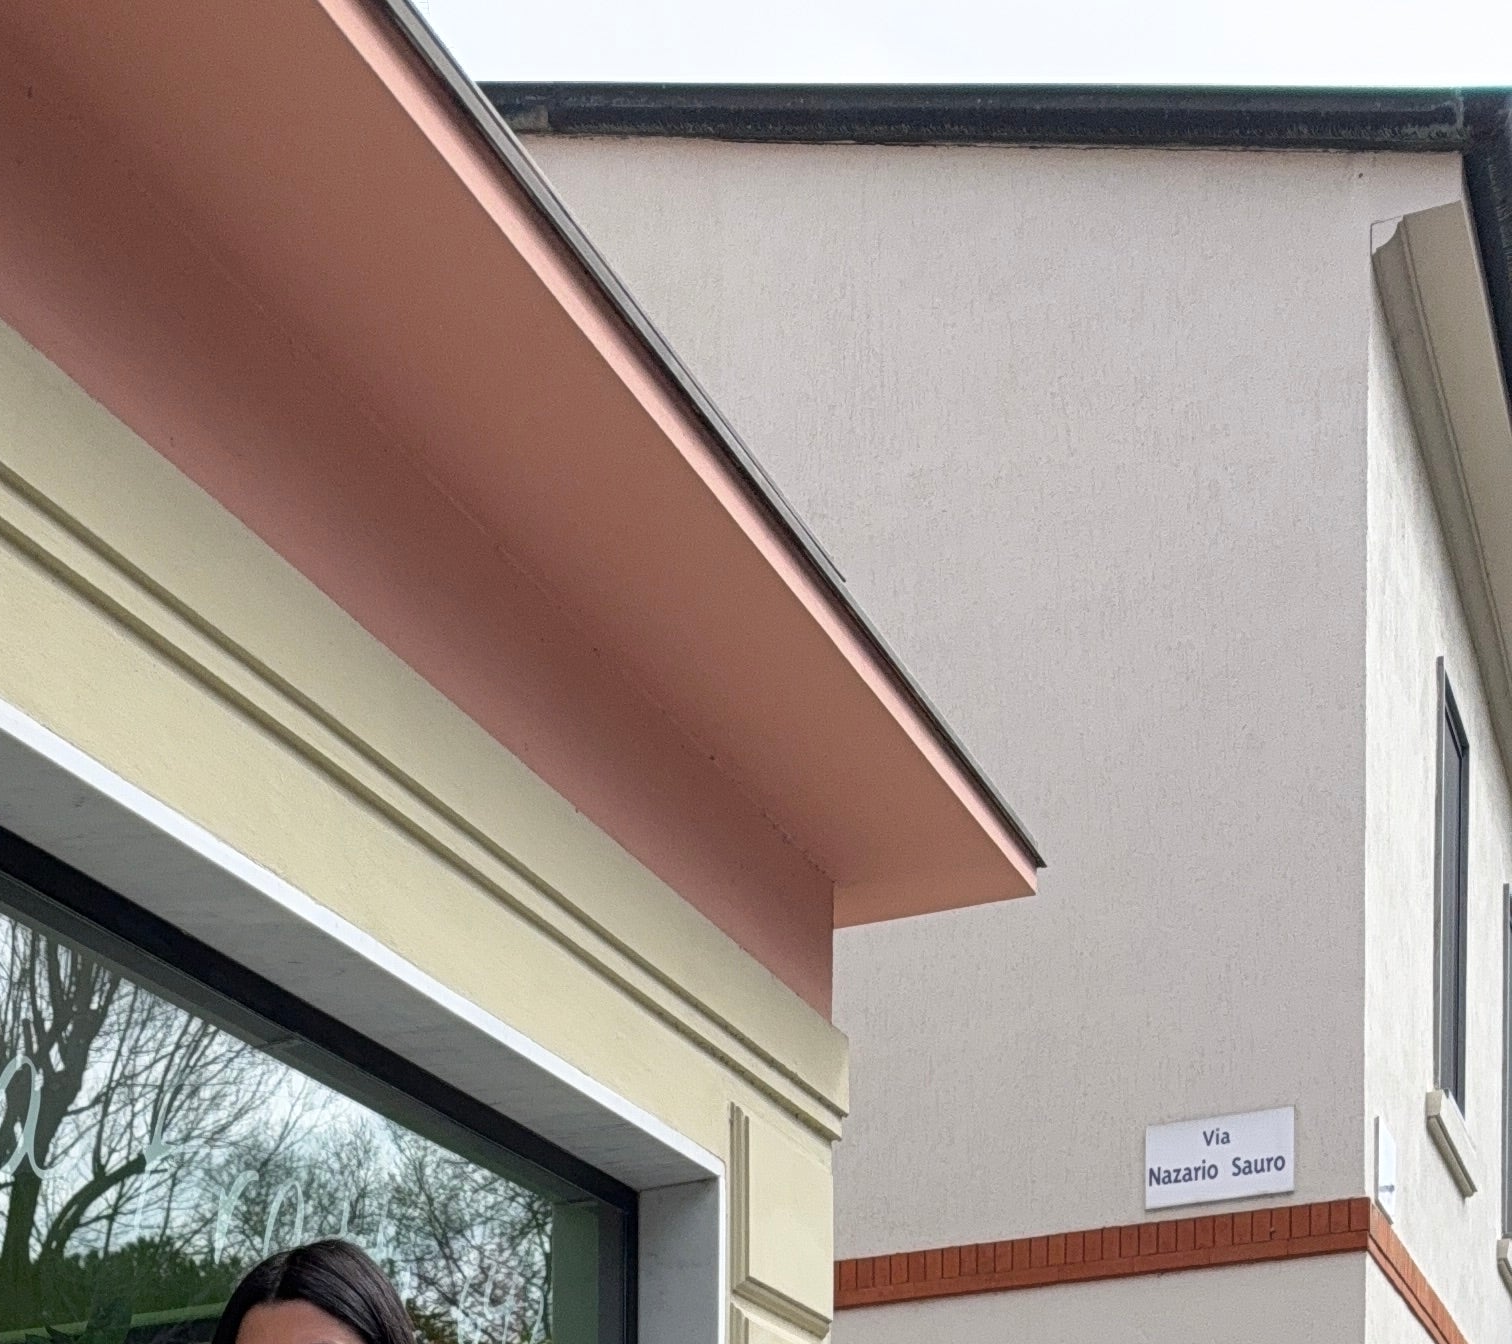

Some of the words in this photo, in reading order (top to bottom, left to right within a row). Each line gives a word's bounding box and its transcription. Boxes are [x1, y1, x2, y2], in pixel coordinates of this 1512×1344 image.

[1202, 1128, 1231, 1146] Via
[1148, 1159, 1219, 1187] Nazario
[1231, 1154, 1286, 1177] Sauro
